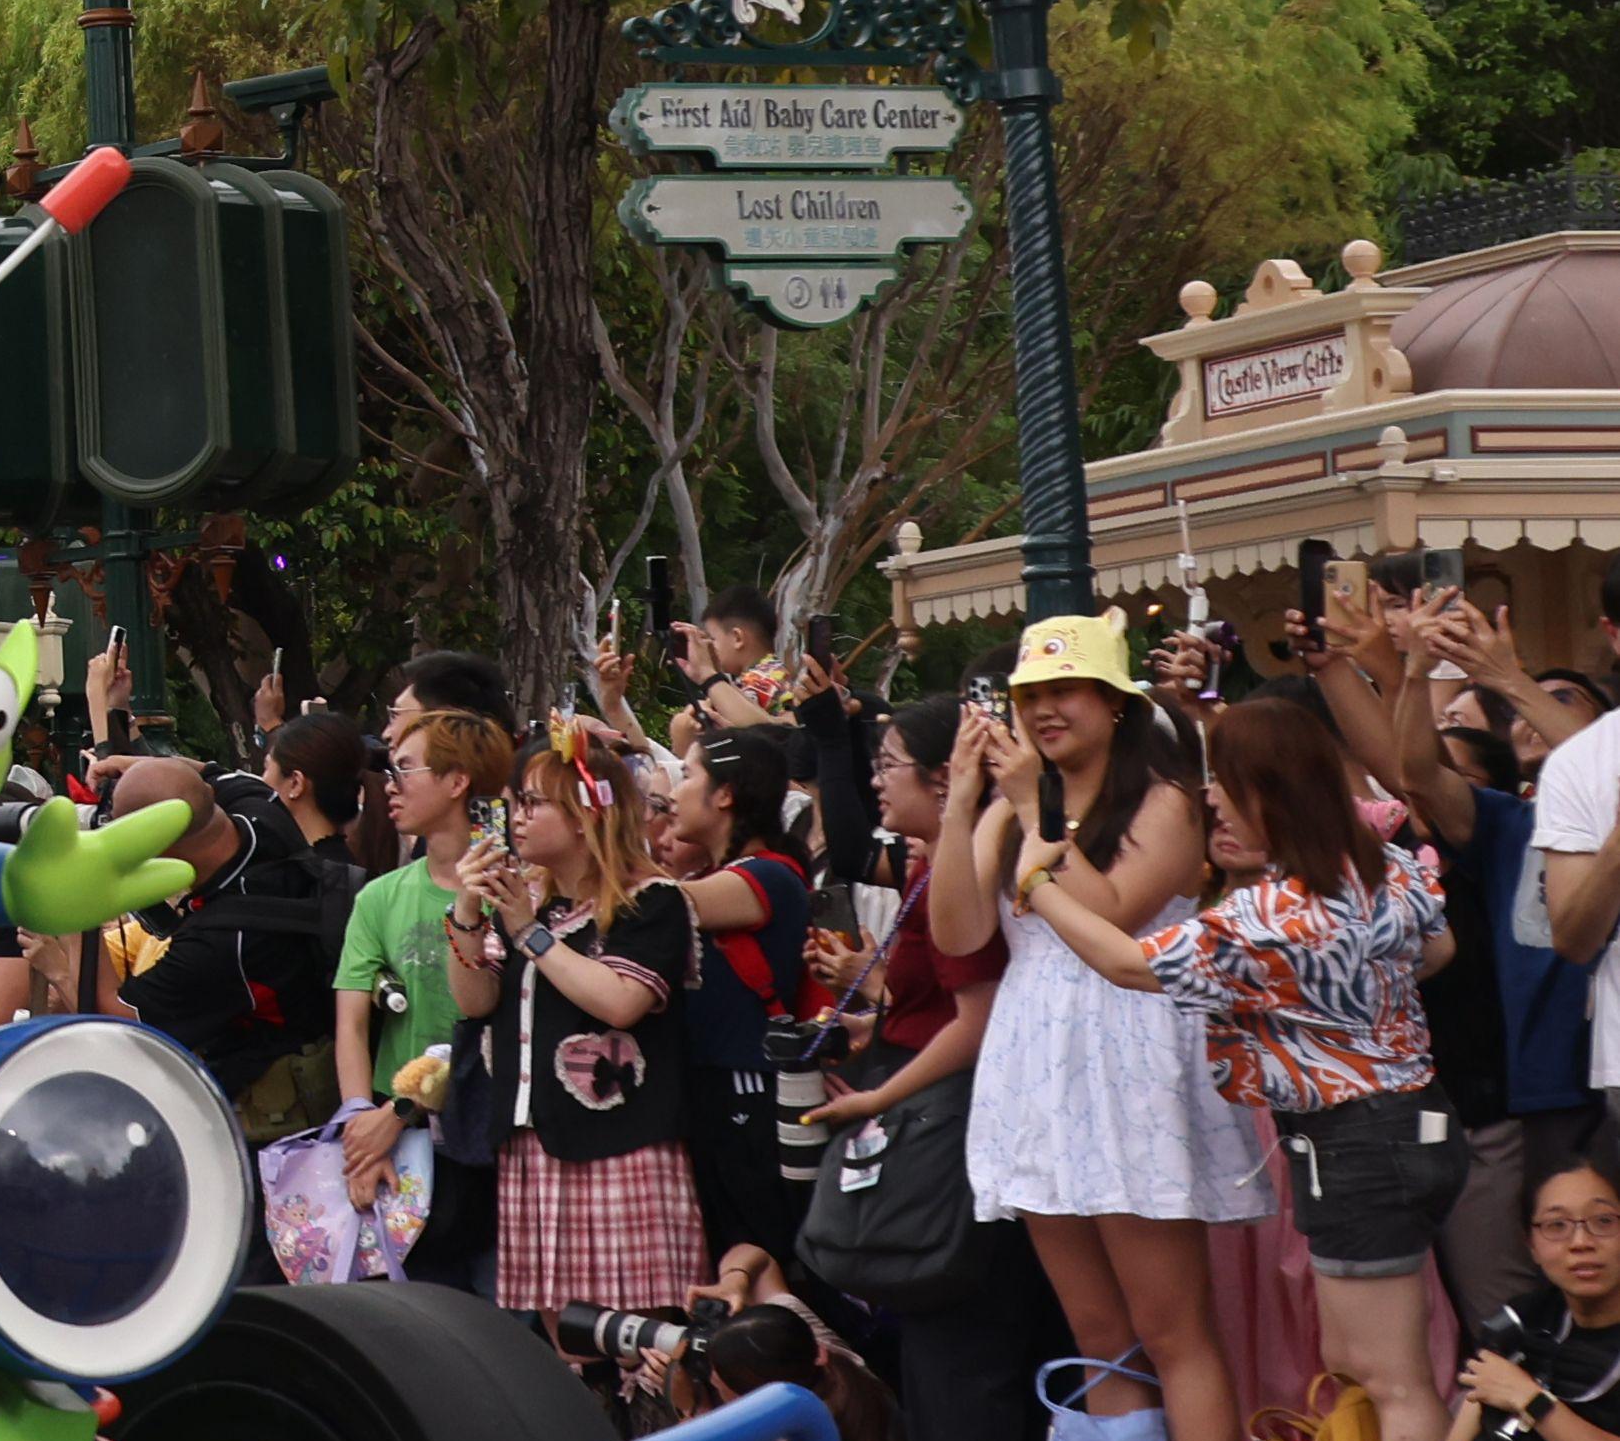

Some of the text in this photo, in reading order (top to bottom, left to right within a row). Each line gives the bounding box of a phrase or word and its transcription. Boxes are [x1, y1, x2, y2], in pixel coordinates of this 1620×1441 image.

[659, 96, 712, 128] First
[820, 99, 867, 129] Care
[873, 99, 940, 129] Center
[737, 190, 881, 221] Lost Children
[1218, 344, 1344, 405] Castle View Gifts
